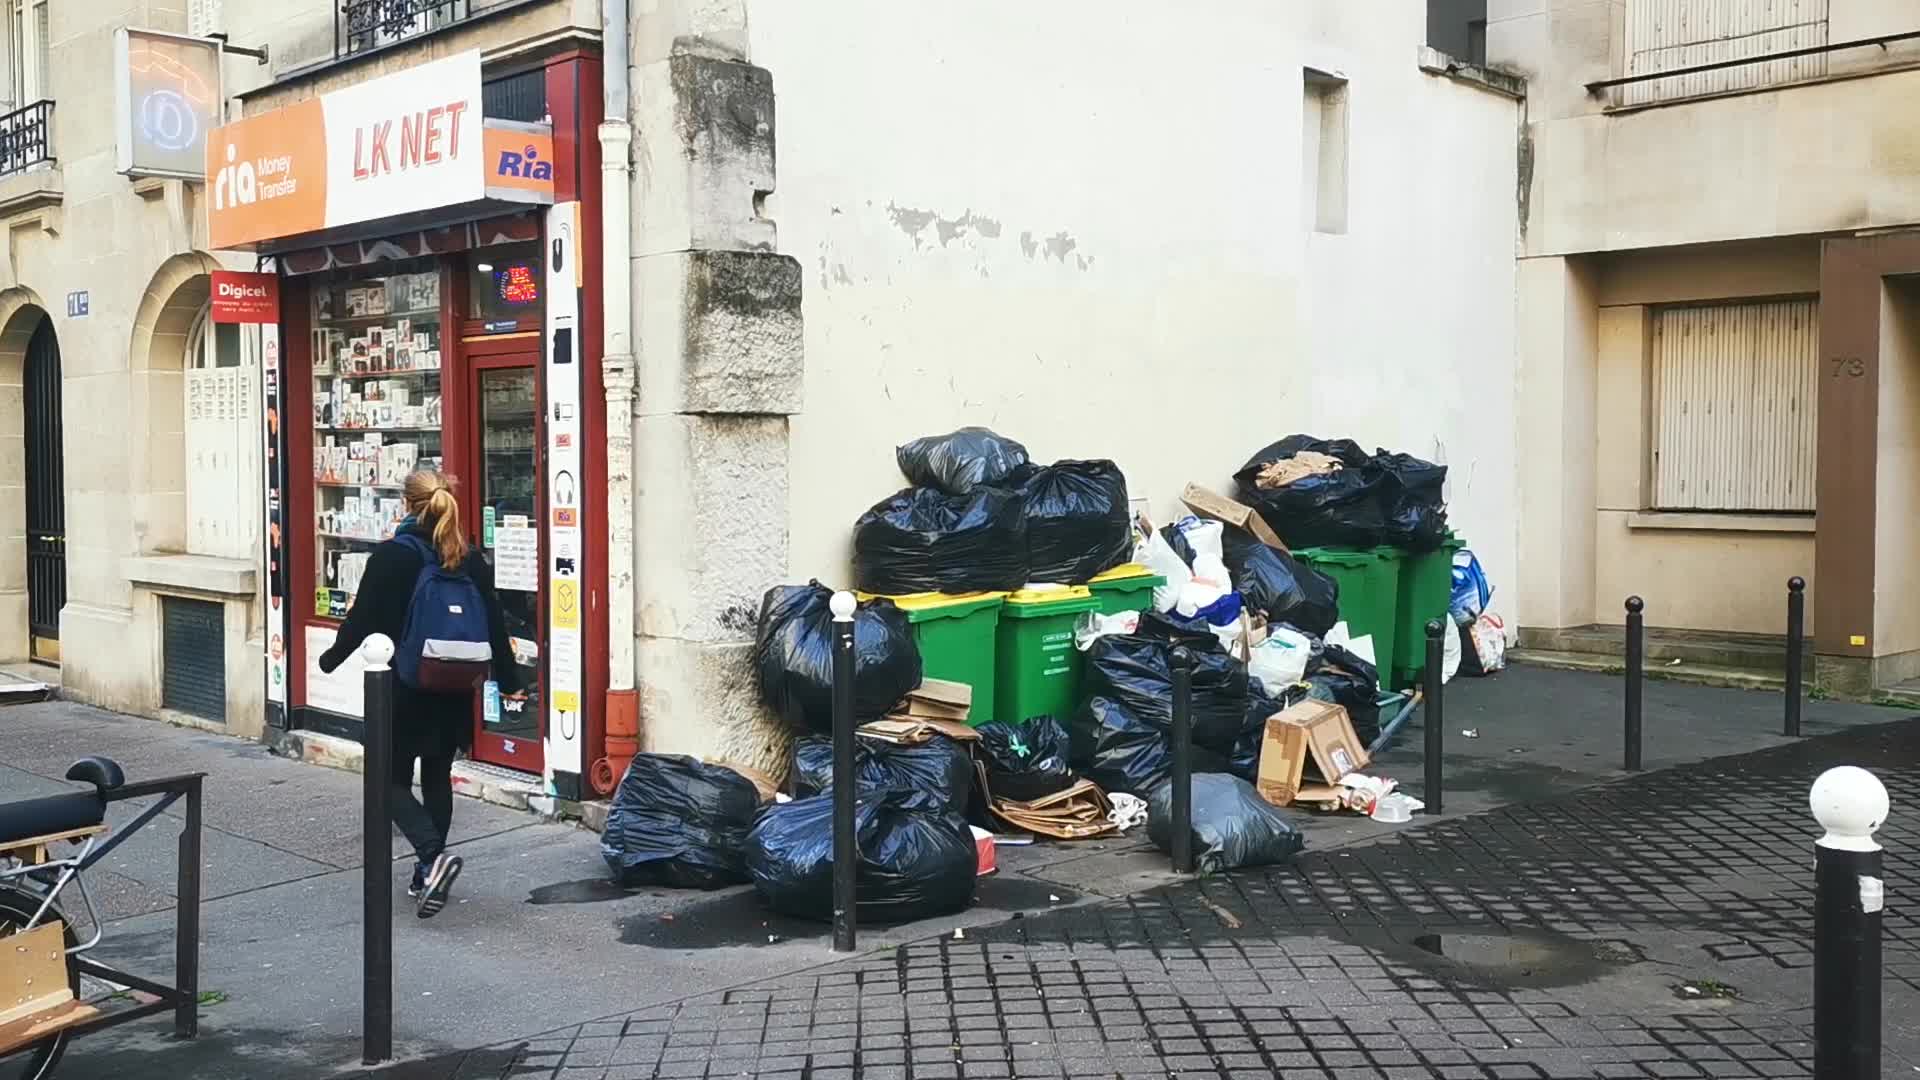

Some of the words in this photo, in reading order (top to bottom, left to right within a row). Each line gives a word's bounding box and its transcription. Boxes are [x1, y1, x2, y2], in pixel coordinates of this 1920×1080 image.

[353, 119, 392, 181] LK
[400, 99, 468, 172] NET
[257, 155, 292, 177] Money
[498, 144, 552, 181] Ria
[215, 143, 257, 210] ria
[257, 175, 297, 201] Transfer
[218, 282, 268, 299] Digicel
[1831, 357, 1865, 377] 73
